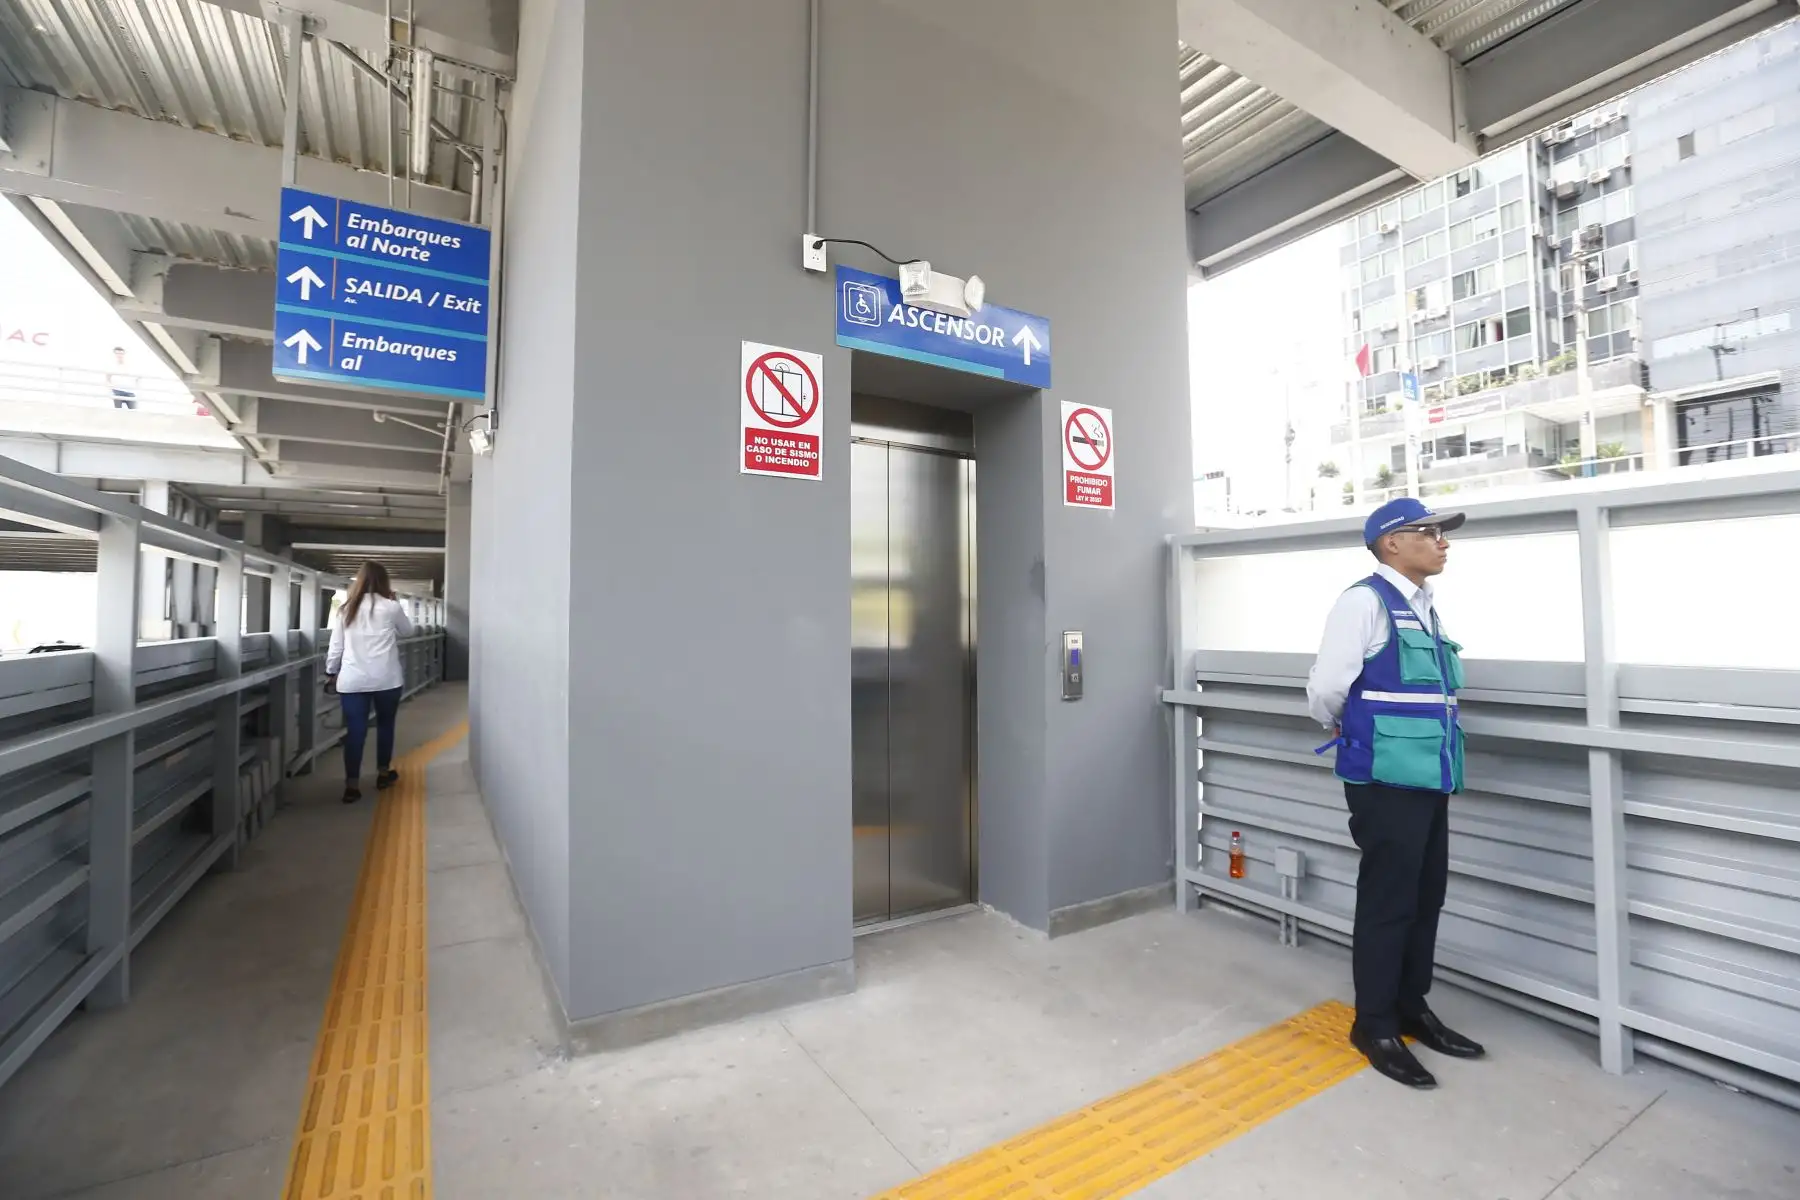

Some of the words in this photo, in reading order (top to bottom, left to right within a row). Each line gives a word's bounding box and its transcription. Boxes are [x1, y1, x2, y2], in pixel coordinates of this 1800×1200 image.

[347, 213, 462, 248] Embarques
[346, 234, 368, 249] al
[371, 237, 431, 262] Norte
[344, 277, 423, 304] SALIDA
[427, 291, 440, 307] /
[443, 294, 482, 314] Exit
[888, 303, 1005, 348] ASCENSOR
[0, 325, 49, 346] AC
[342, 331, 457, 362] Embarques
[340, 355, 363, 371] al
[754, 436, 768, 444] NO
[771, 438, 796, 448] USAR
[798, 442, 811, 450] EN
[746, 445, 772, 454] CASO
[775, 448, 787, 456] DE
[789, 449, 818, 460] SISMO
[765, 455, 810, 467] INCENDIO
[1070, 475, 1108, 487] PROHIBIDO
[1077, 486, 1101, 495] FUMAR
